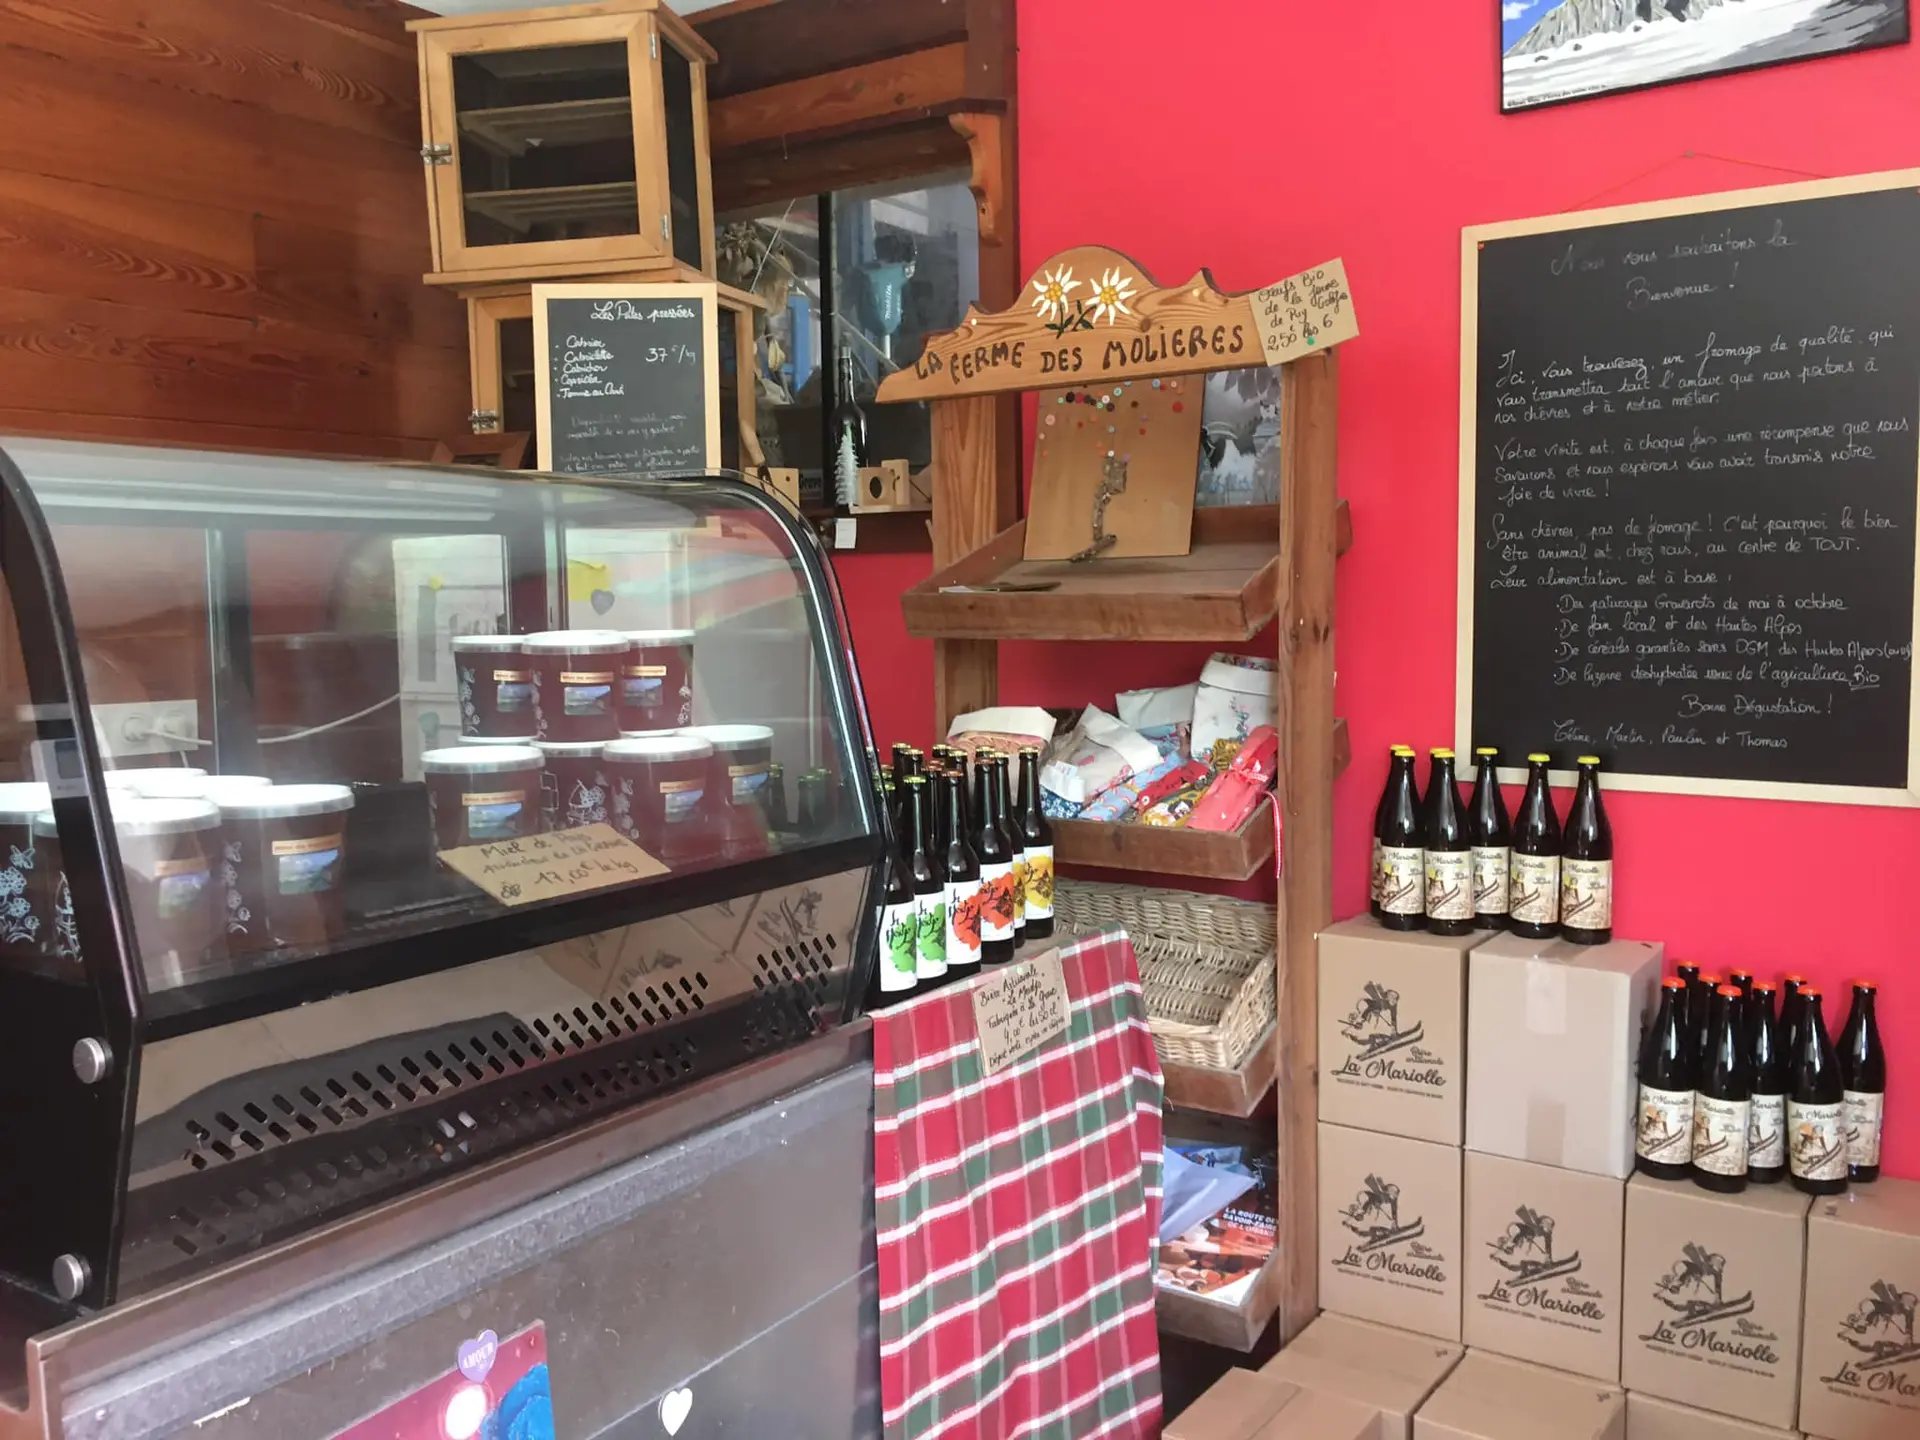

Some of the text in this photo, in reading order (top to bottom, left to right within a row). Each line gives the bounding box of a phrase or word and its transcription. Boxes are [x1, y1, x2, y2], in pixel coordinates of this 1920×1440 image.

[1623, 251, 1657, 265] vous
[1767, 218, 1797, 246] la
[1626, 276, 1717, 311] Bienvenue
[1265, 300, 1279, 315] de
[1323, 314, 1333, 328] 6
[914, 351, 943, 380] LA
[949, 341, 1025, 385] FERME
[1040, 346, 1083, 373] DES
[1543, 361, 1573, 378] vous
[1663, 355, 1684, 365] un
[1696, 332, 1762, 378] fromage
[1770, 335, 1788, 352] de
[1869, 324, 1895, 346] qui
[1497, 396, 1526, 408] vous
[1533, 378, 1611, 401] transmettra
[1730, 373, 1753, 390] que
[1763, 370, 1791, 380] nous
[1798, 357, 1854, 383] portons
[1865, 357, 1878, 372] à
[1495, 412, 1516, 423] nos
[1524, 405, 1571, 422] chèvres
[1583, 400, 1598, 414] et
[1604, 401, 1615, 413] à
[1626, 397, 1663, 411] notre
[1495, 437, 1537, 461] Votre
[1544, 439, 1583, 456] visite
[1624, 438, 1634, 451] à
[1639, 433, 1684, 450] chaque
[1725, 431, 1752, 442] une
[1760, 424, 1835, 443] récompense
[1843, 421, 1869, 439] que
[1877, 418, 1909, 432] nous
[1566, 464, 1580, 477] et
[1586, 464, 1613, 475] nous
[1687, 457, 1714, 470] vous
[1720, 453, 1755, 468] avoir
[1765, 448, 1823, 465] transmis
[1831, 444, 1877, 462] notre
[1539, 485, 1555, 499] de
[1563, 486, 1597, 498] vivre
[1487, 513, 1524, 549] Sans
[1589, 525, 1614, 542] pas
[1624, 517, 1643, 536] de
[1648, 513, 1703, 543] fromage
[1723, 513, 1758, 532] C'est
[1764, 513, 1828, 535] pourquoi
[1841, 505, 1856, 529] le
[1863, 508, 1899, 529] bien
[1501, 544, 1529, 561] être
[1538, 544, 1588, 560] animal
[1626, 543, 1654, 564] chez
[1707, 544, 1727, 554] au
[1738, 539, 1777, 554] centre
[1785, 537, 1802, 553] de
[1490, 565, 1719, 589] Leur alimentation est à base
[1723, 597, 1739, 610] de
[1748, 597, 1770, 609] mai
[1777, 594, 1786, 609] à
[1795, 592, 1849, 610] octobre
[1559, 618, 1579, 639] De
[1622, 611, 1656, 632] local
[1665, 618, 1680, 631] et
[1686, 616, 1708, 631] des
[1715, 614, 1757, 633] Hautes
[1764, 614, 1802, 639] Alpes
[1555, 641, 1580, 663] De
[1588, 636, 1630, 655] céréales
[1636, 638, 1690, 661] garanties
[1735, 638, 1769, 657] OGM
[1778, 641, 1797, 655] des
[1805, 639, 1844, 658] Hautes
[1847, 641, 1884, 661] Alpes
[1554, 666, 1576, 685] De
[1584, 662, 1622, 687] luzerne
[1736, 664, 1752, 680] de
[1759, 661, 1849, 688] l'agriculture
[1849, 664, 1880, 688] Bio
[1678, 694, 1726, 718] Bonne
[1733, 694, 1821, 719] Dégustation
[1716, 732, 1730, 744] et
[1736, 731, 1788, 748] Thomas
[480, 842, 521, 859] Miel
[1038, 1011, 1048, 1023] 50
[1331, 1055, 1446, 1086] La Mariolle
[1331, 1245, 1361, 1267] La
[1366, 1252, 1446, 1283] Mariolle
[1477, 1279, 1511, 1303] La
[1516, 1286, 1605, 1320] Mariolle
[1638, 1320, 1676, 1344] La
[1681, 1328, 1779, 1364] Mariolle
[1819, 1361, 1861, 1387] La
